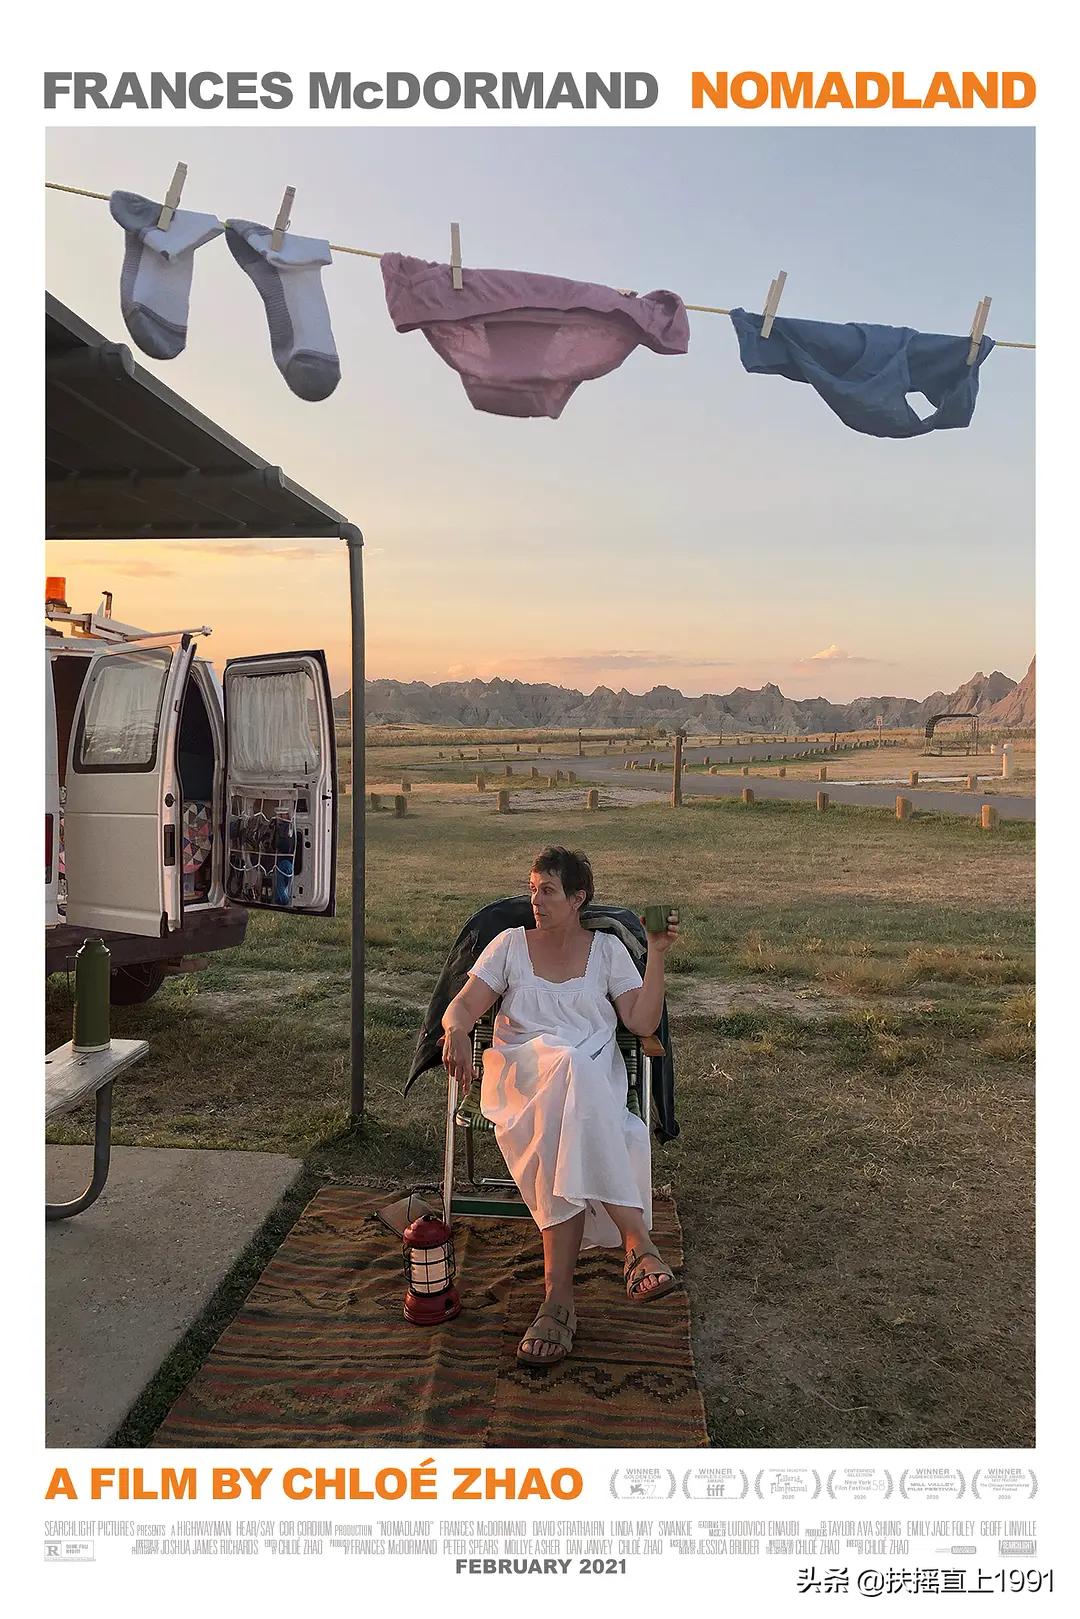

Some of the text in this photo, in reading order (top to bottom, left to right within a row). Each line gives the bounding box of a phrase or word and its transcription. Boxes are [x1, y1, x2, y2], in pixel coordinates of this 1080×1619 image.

[44, 72, 658, 109] FRANCES McDORMAND
[691, 71, 1036, 109] NOMADLAND
[45, 1458, 584, 1501] A FILM BY CHLOÉ ZHAO
[706, 1484, 725, 1497] tiff
[45, 1521, 97, 1537] SEARCHLIGHT
[98, 1521, 135, 1537] PICTURES
[176, 1521, 232, 1537] HIGHWAYMAN
[236, 1521, 276, 1537] HEAR/SAY
[439, 1521, 475, 1537] FRANCES
[476, 1521, 527, 1537] McDORMAND
[532, 1521, 556, 1537] DAVID
[556, 1521, 605, 1537] STRATHAIRN
[610, 1521, 634, 1537] LINDA
[636, 1521, 654, 1537] MAY
[658, 1521, 693, 1537] SWANKIE
[728, 1521, 766, 1537] LUDOVICO
[767, 1521, 800, 1537] EINAUDI
[828, 1521, 856, 1537] TAYLOR
[857, 1521, 874, 1537] AVA
[875, 1521, 902, 1537] SHUNG
[906, 1521, 930, 1537] EMILY
[931, 1521, 951, 1537] JADE
[951, 1521, 976, 1537] FOLEY
[980, 1521, 1003, 1537] GEOFF
[1004, 1521, 1037, 1537] LINVILLE
[46, 1545, 60, 1557] R
[160, 1539, 191, 1555] JOSHUA
[191, 1539, 219, 1555] JAMES
[219, 1539, 259, 1555] RICHARDS
[302, 1539, 323, 1555] ZHAO
[350, 1539, 386, 1555] FRANCES
[387, 1539, 438, 1555] McDORMAND
[443, 1539, 467, 1555] PETER
[468, 1539, 499, 1555] SPEARS
[504, 1539, 533, 1555] MOLLYE
[534, 1539, 561, 1555] ASHER
[566, 1539, 583, 1555] DAN
[583, 1539, 614, 1555] JANVEY
[643, 1539, 663, 1555] ZHAO
[696, 1539, 728, 1555] JESSICA
[729, 1539, 760, 1555] BRUDER
[819, 1539, 840, 1555] ZHAO
[889, 1539, 910, 1555] ZHAO
[456, 1558, 626, 1575] FEBRUARY 2021
